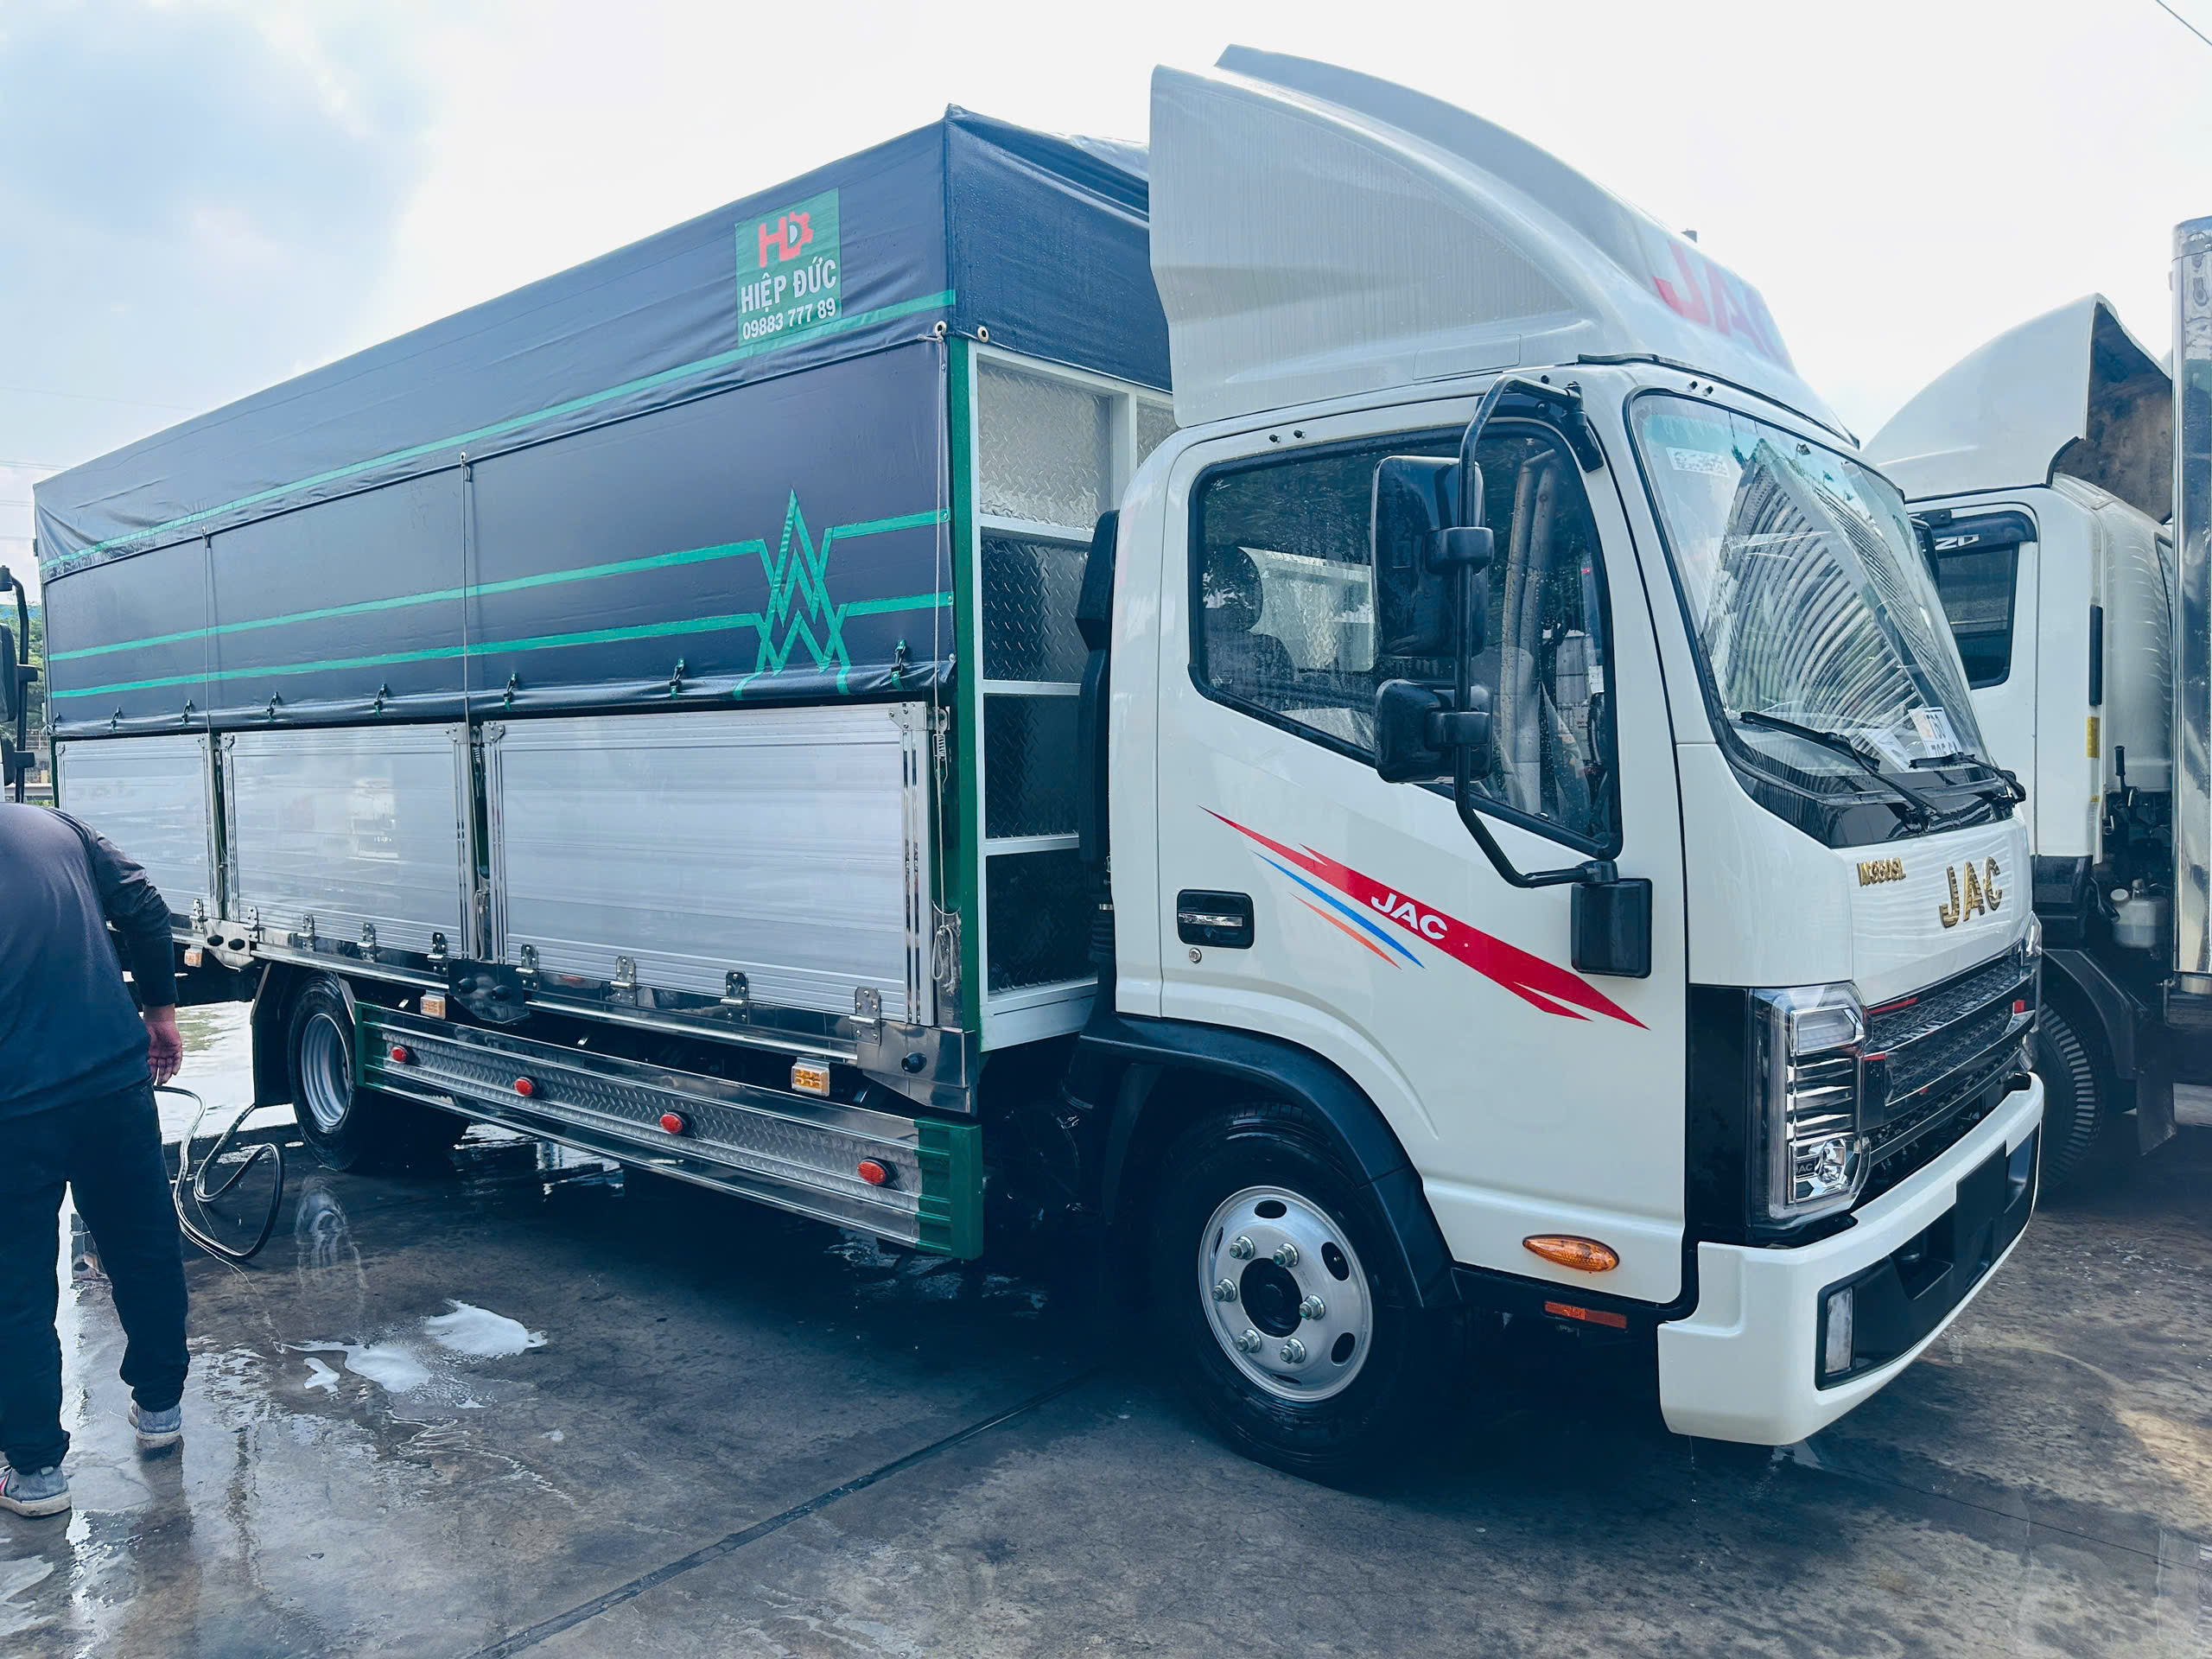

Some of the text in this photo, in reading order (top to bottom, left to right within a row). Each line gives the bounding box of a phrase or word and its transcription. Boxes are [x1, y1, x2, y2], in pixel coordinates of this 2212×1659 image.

[741, 257, 836, 314] HIỆP ĐỨC
[743, 297, 836, 340] 09883 777 89
[1370, 893, 1448, 940] JAC
[1939, 856, 2003, 929] JAC
